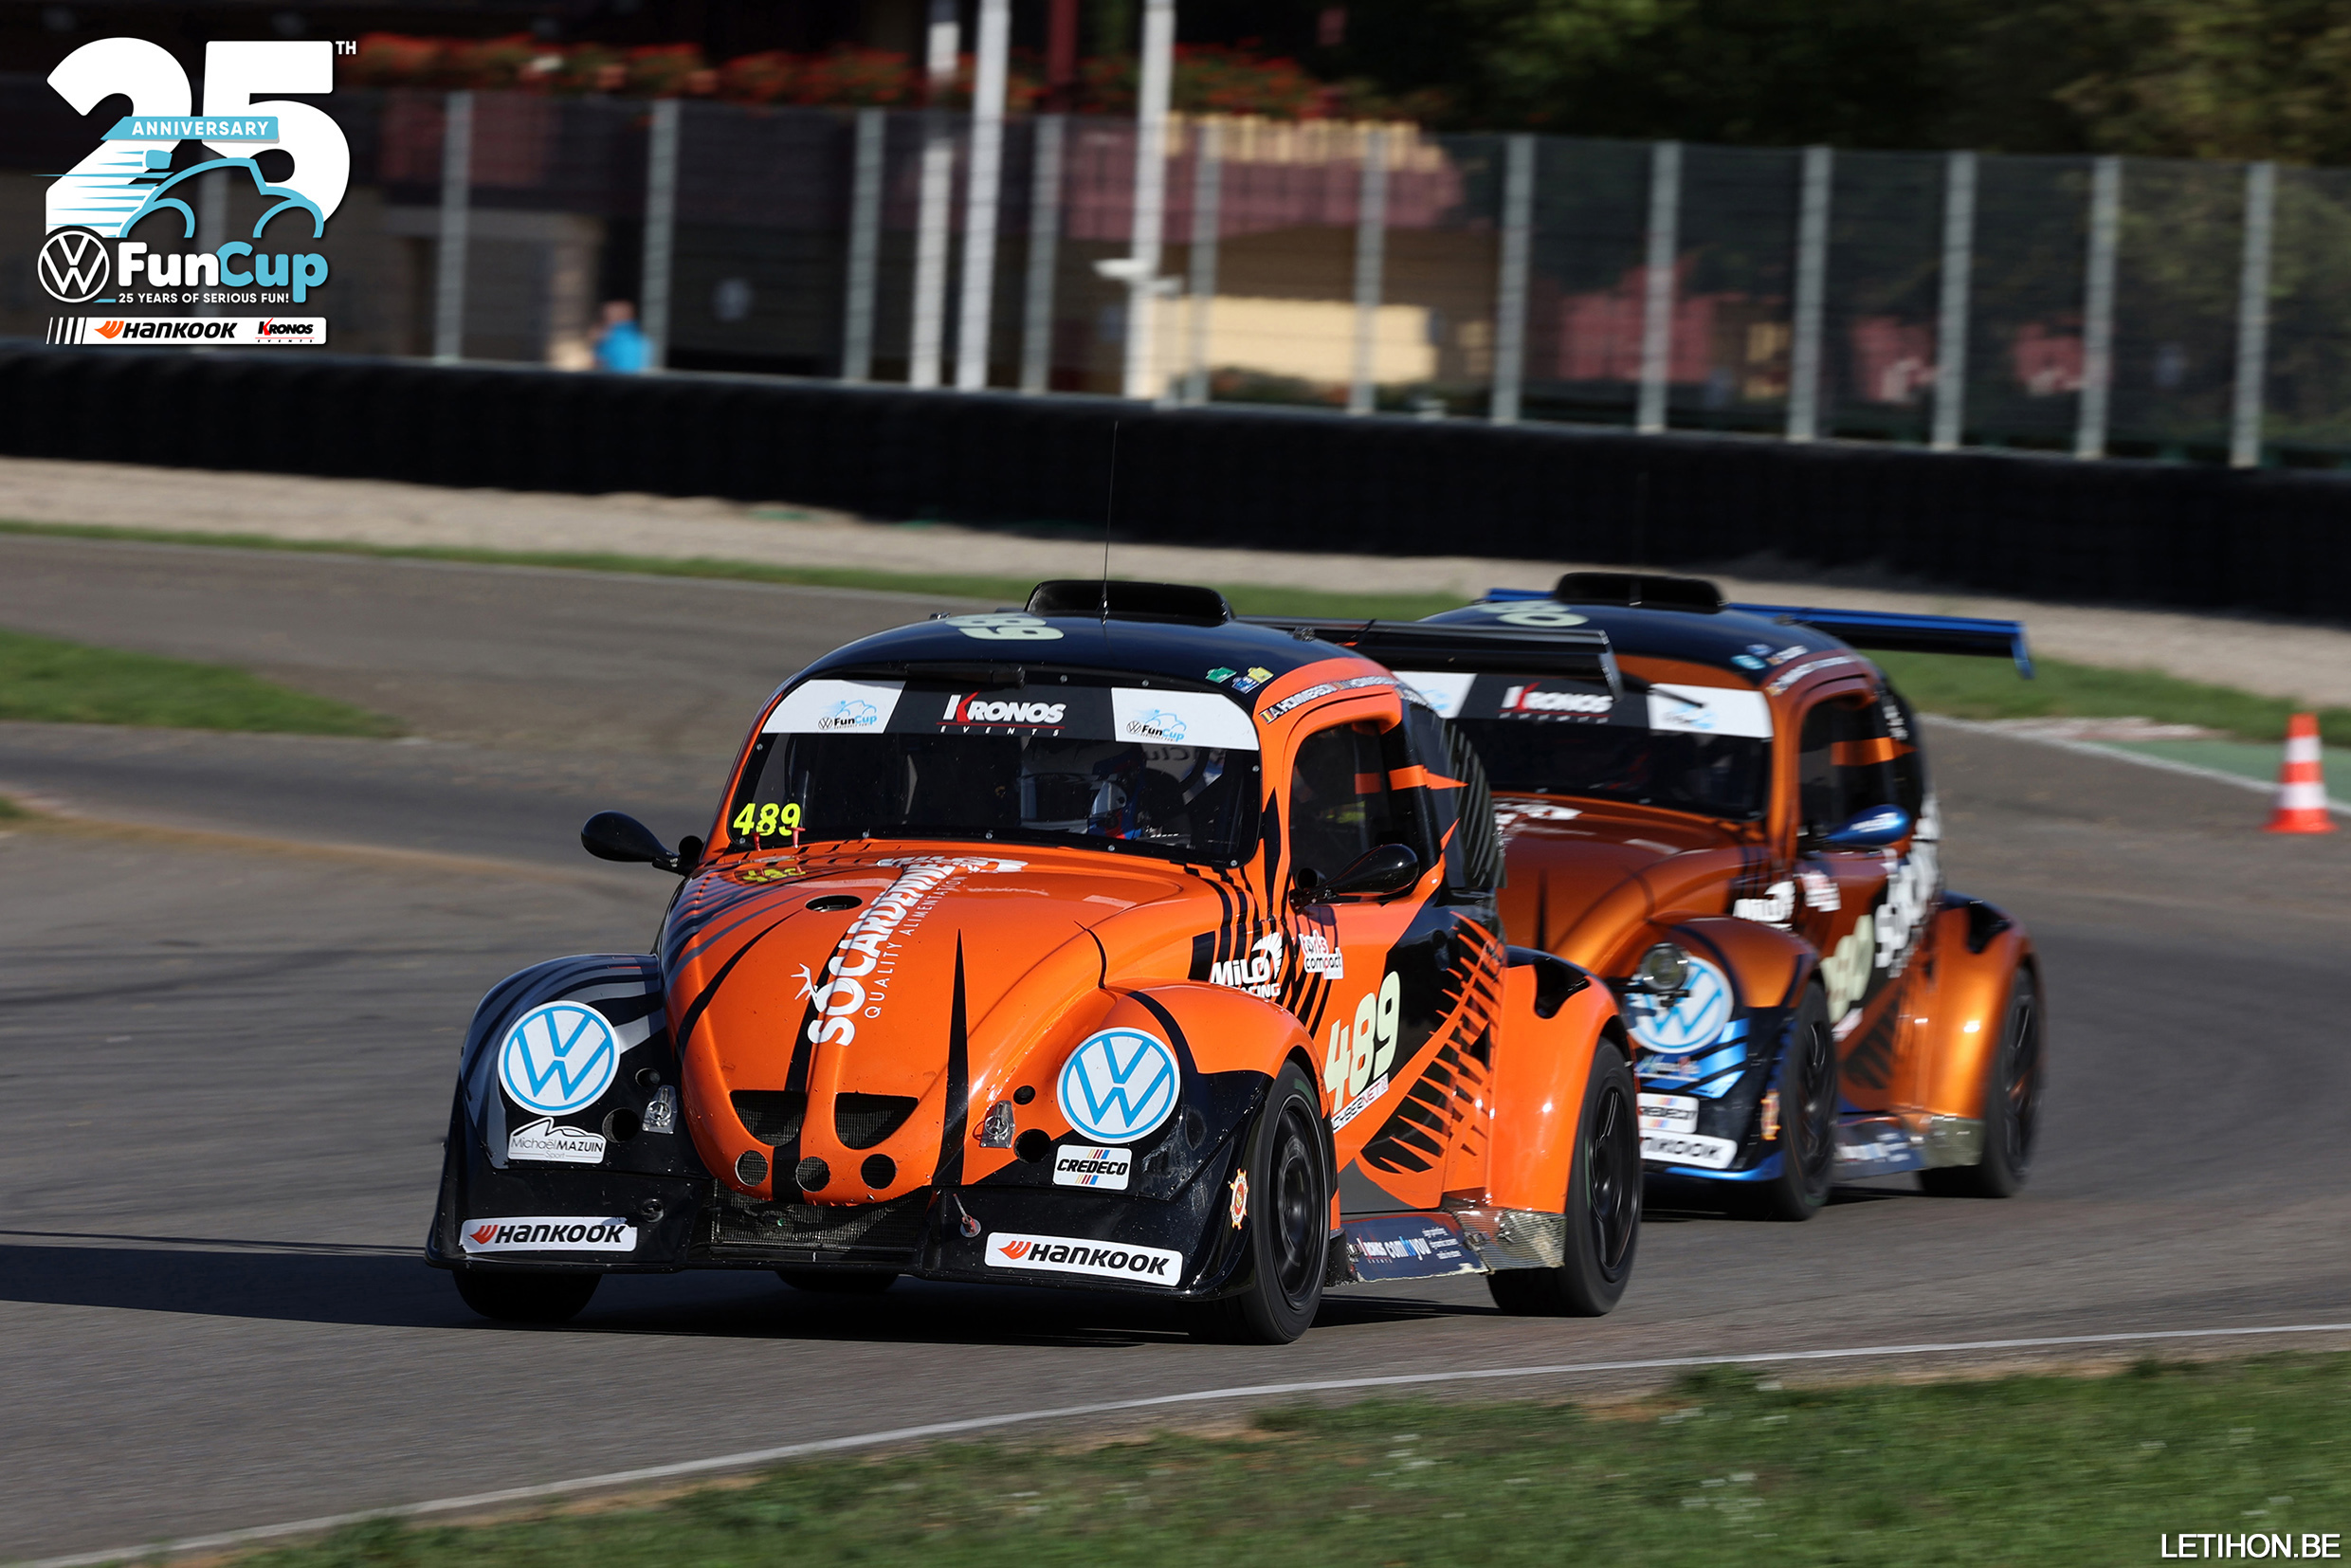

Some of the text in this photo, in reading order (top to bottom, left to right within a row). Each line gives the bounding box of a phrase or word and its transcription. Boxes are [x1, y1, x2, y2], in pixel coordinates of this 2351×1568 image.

[834, 715, 878, 725] FunCup
[942, 689, 1066, 723] KRONOS
[939, 725, 1060, 737] EVENTS
[1141, 724, 1185, 742] FunCup
[733, 803, 802, 836] 489
[899, 875, 968, 937] ALIMENTATION
[808, 863, 957, 1047] SOCARDENNE
[1304, 950, 1342, 976] compact
[864, 941, 902, 1019] QUALITY
[1323, 971, 1401, 1114] 489
[1056, 1158, 1129, 1176] CREDECO
